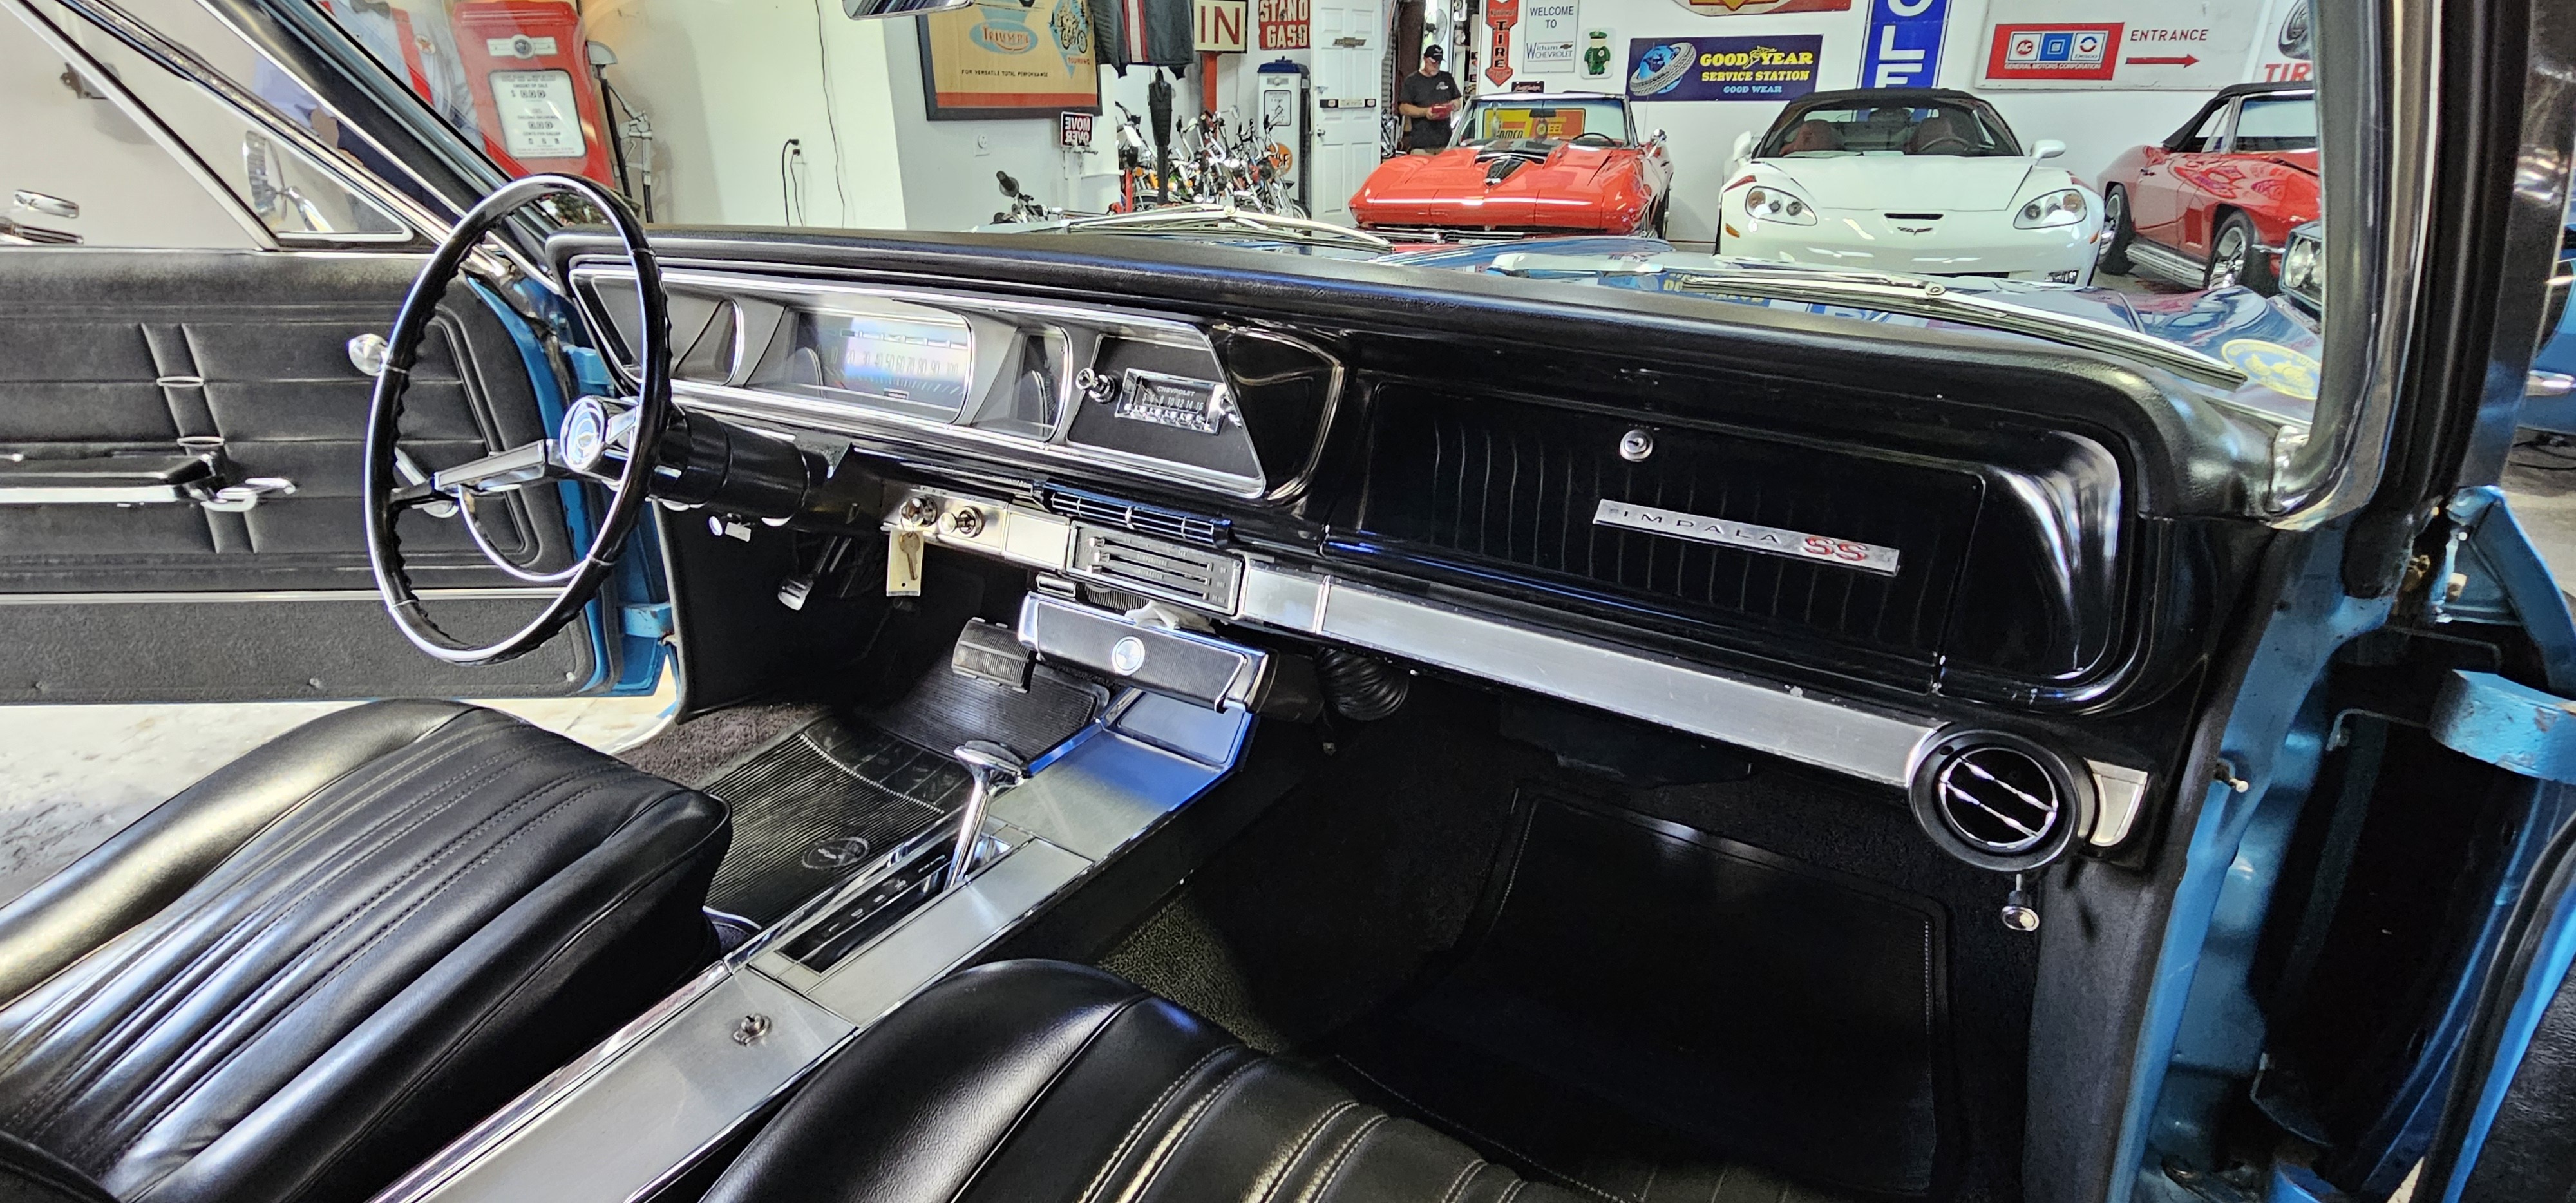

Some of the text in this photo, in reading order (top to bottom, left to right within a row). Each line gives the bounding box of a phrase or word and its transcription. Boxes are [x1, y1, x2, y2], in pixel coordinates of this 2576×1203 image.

[1530, 6, 1574, 16] WELCOME
[1200, 6, 1240, 45] IN
[1546, 19, 1557, 28] TO
[983, 26, 1030, 43] TRIUMPH
[1267, 24, 1307, 48] GASO
[2130, 29, 2209, 41] ENTRANCE
[1493, 21, 1507, 68] TIRE
[1526, 42, 1558, 59] Witham
[2016, 39, 2033, 52] AC
[1535, 50, 1573, 59] CHEVROLET
[1701, 71, 1810, 82] SERVICE STATION
[1157, 386, 1195, 397] CHEVROLET
[1623, 509, 1867, 562] IMPALA SS
